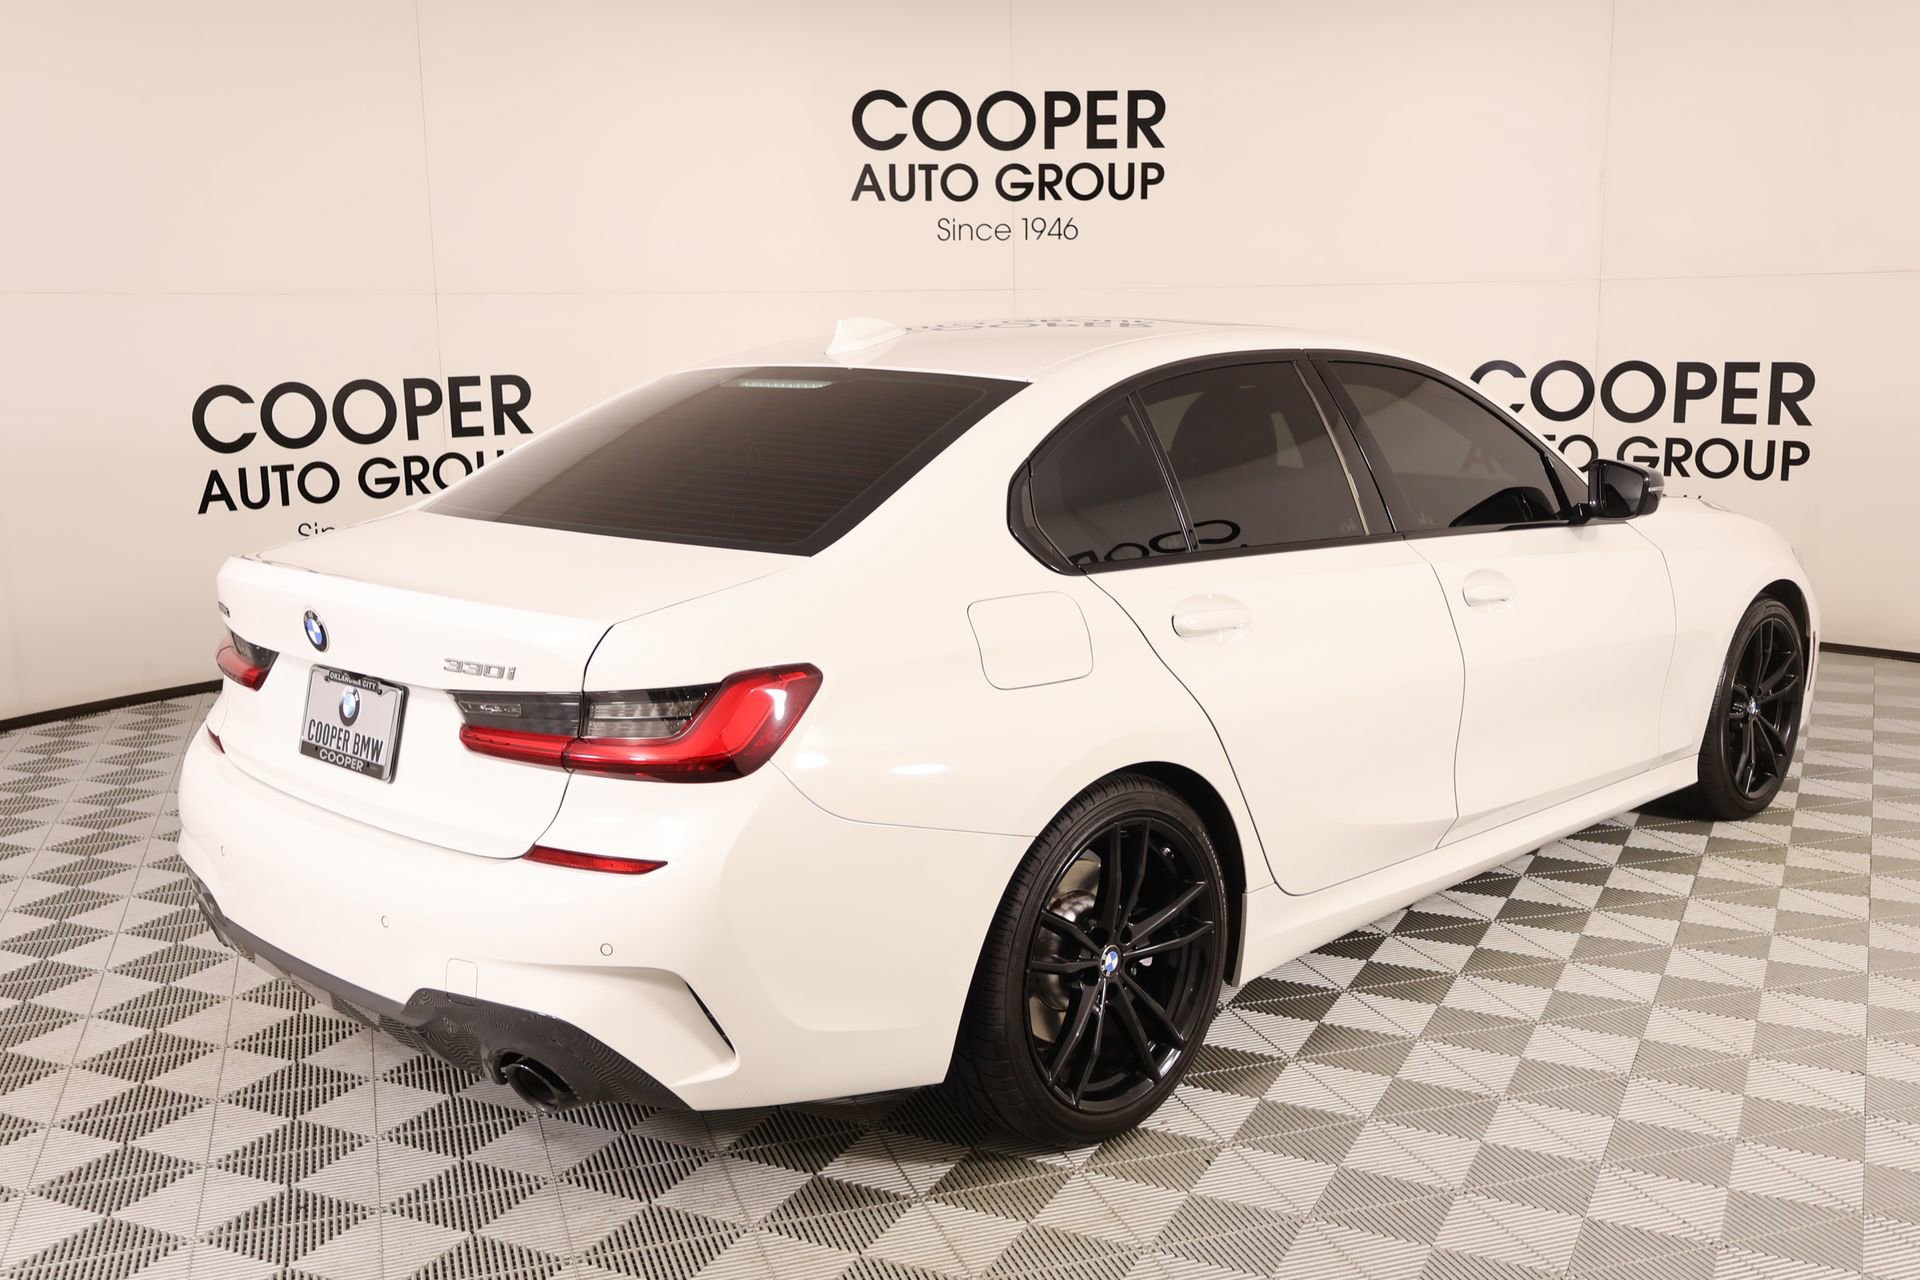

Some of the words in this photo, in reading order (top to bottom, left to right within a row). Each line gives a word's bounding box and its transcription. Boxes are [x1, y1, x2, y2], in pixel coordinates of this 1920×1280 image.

[851, 89, 1167, 152] COOPER
[850, 162, 979, 203] AUTO
[994, 161, 1165, 203] GROUP
[937, 217, 1012, 242] Since
[1021, 216, 1079, 241] 1946
[191, 374, 534, 455] COOPER
[1616, 435, 1811, 482] GROUP
[197, 460, 341, 516] AUTO
[357, 450, 505, 500] GRO
[443, 657, 516, 681] 330i
[307, 718, 350, 753] COOPER
[352, 732, 384, 763] BMW
[319, 748, 364, 772] COOPER
